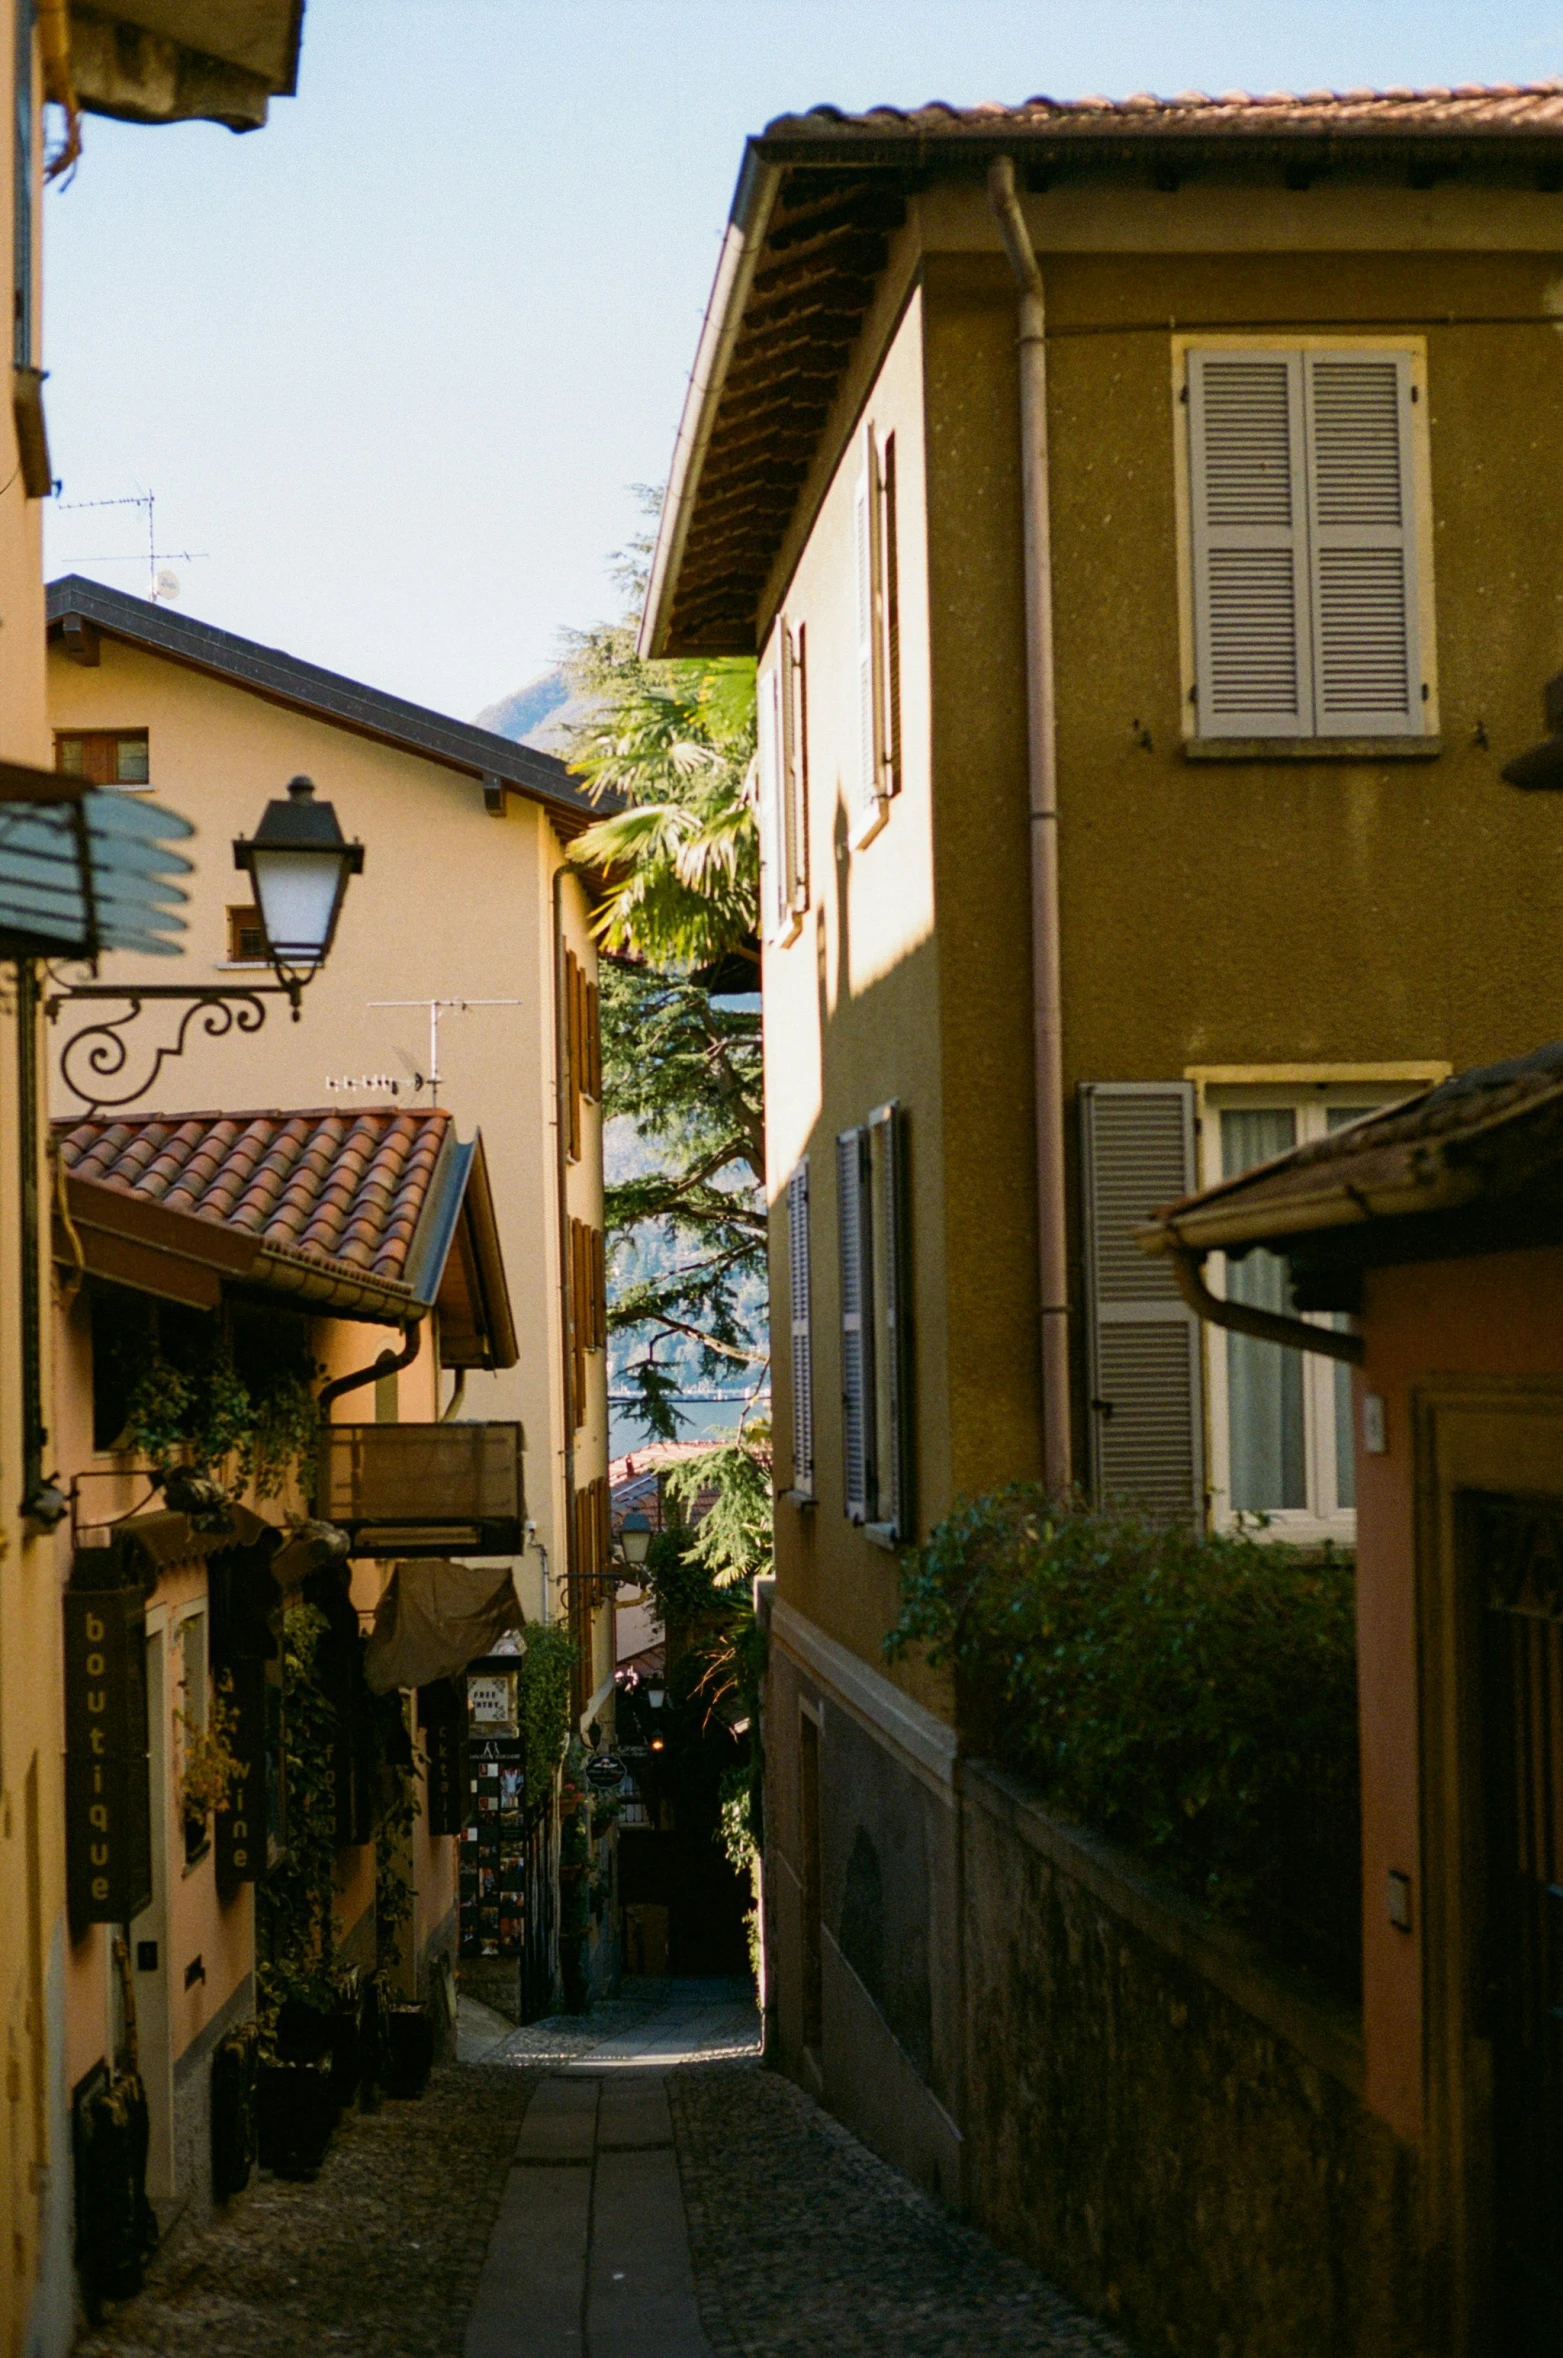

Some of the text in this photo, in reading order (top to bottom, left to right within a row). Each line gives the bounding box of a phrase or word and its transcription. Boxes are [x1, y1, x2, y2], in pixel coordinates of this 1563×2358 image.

[473, 1691, 496, 1699] FREE
[473, 1701, 499, 1709] NTRY
[85, 1612, 110, 1902] boutique
[231, 1762, 251, 1869] wine
